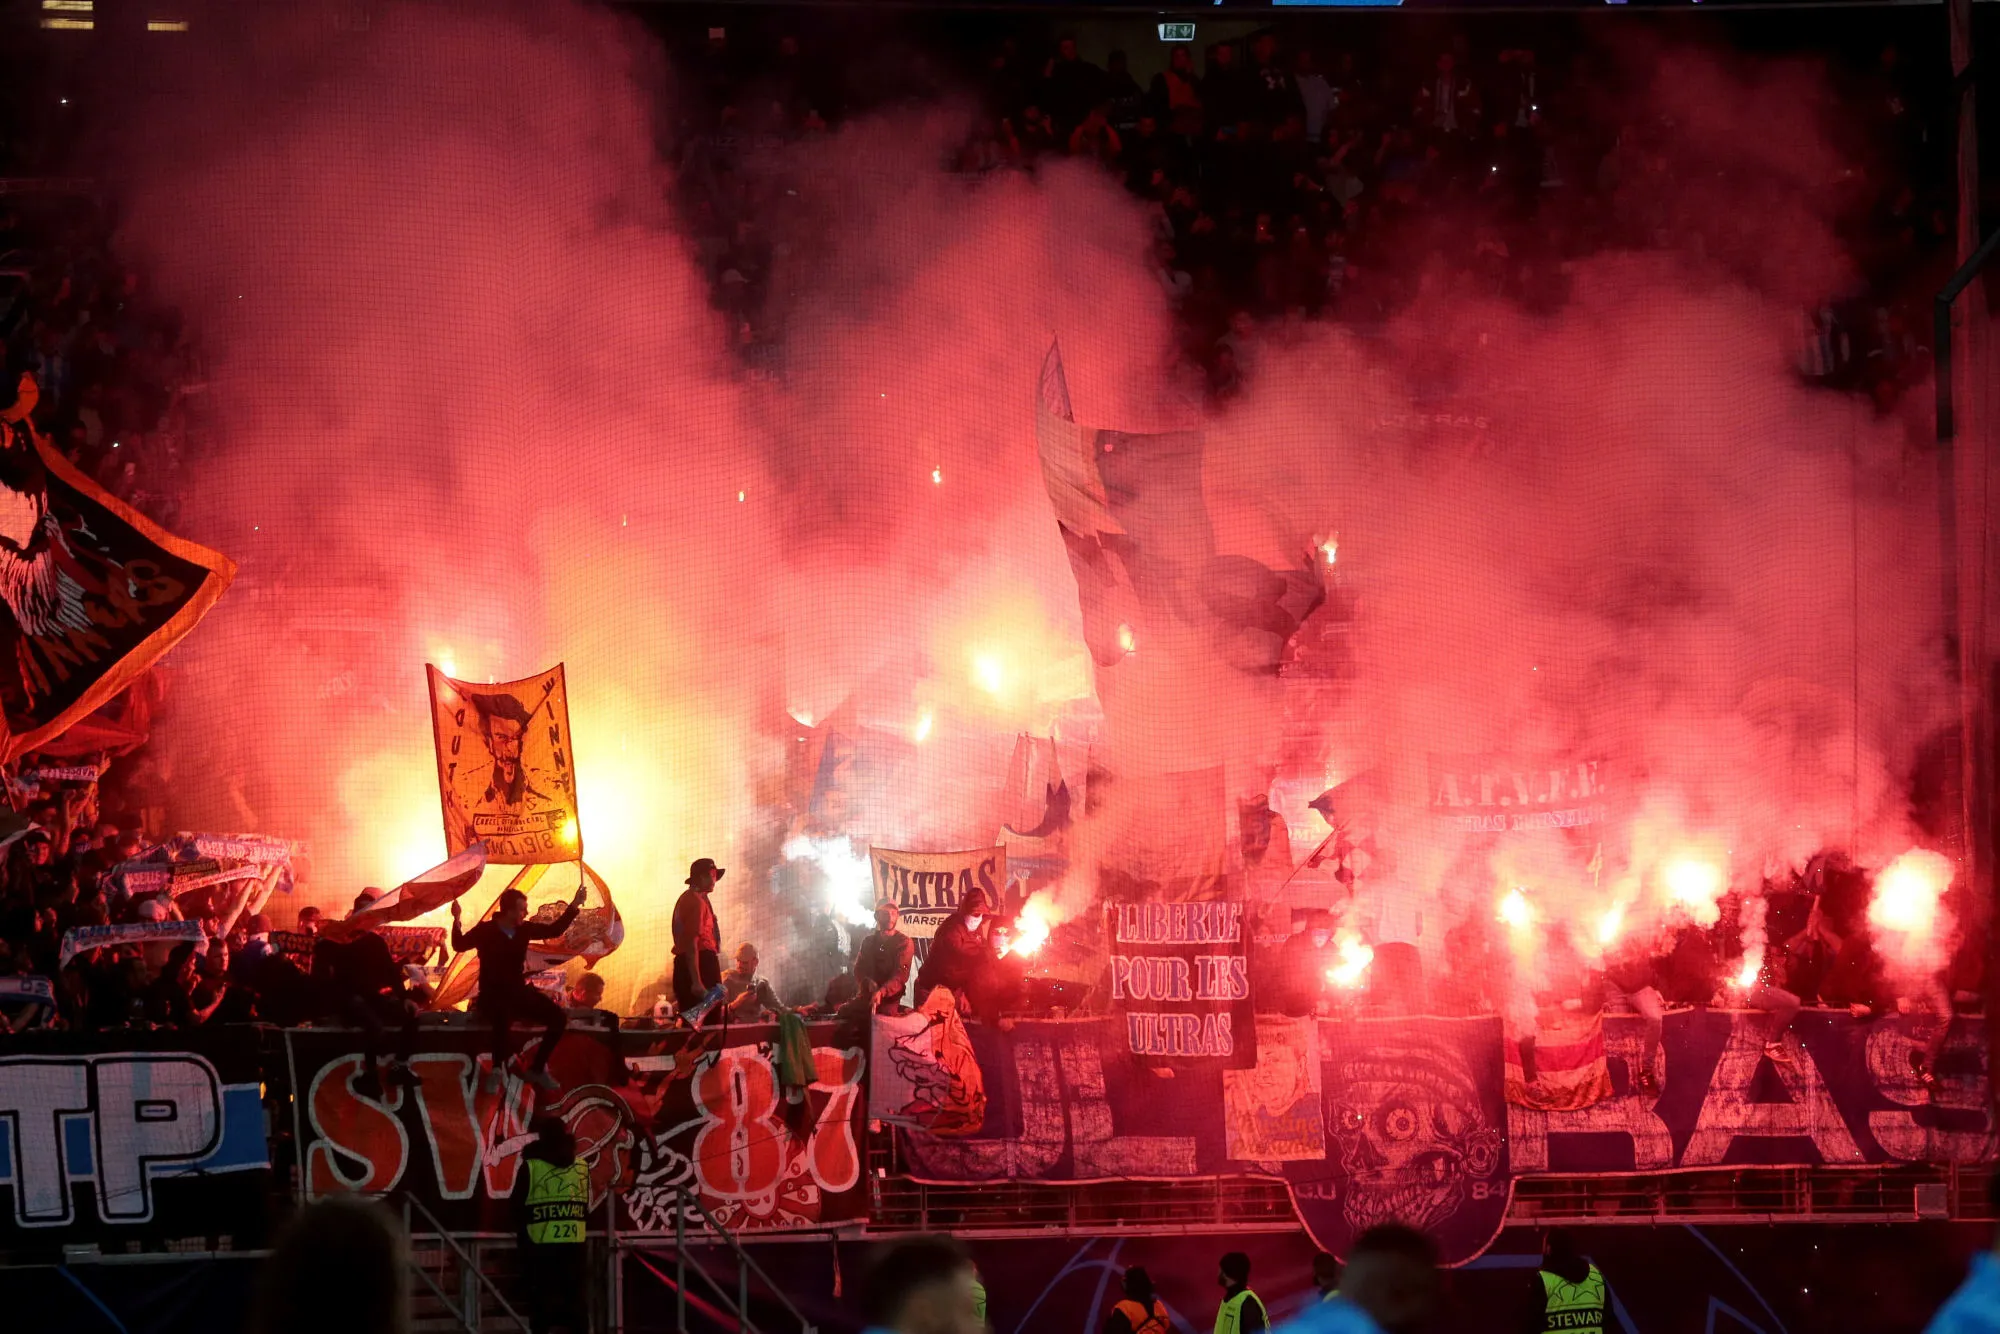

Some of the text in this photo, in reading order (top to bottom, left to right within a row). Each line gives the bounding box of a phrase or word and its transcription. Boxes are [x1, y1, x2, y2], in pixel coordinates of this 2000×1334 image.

[879, 856, 999, 911] ULTRAS
[903, 915, 945, 926] MARSE
[1110, 955, 1250, 1002] POUR LES
[1126, 1012, 1235, 1057] ULTRAS
[691, 1044, 865, 1200] 87
[1471, 1180, 1508, 1200] 84
[552, 1223, 578, 1239] 229
[1547, 1311, 1603, 1328] STEWAR
